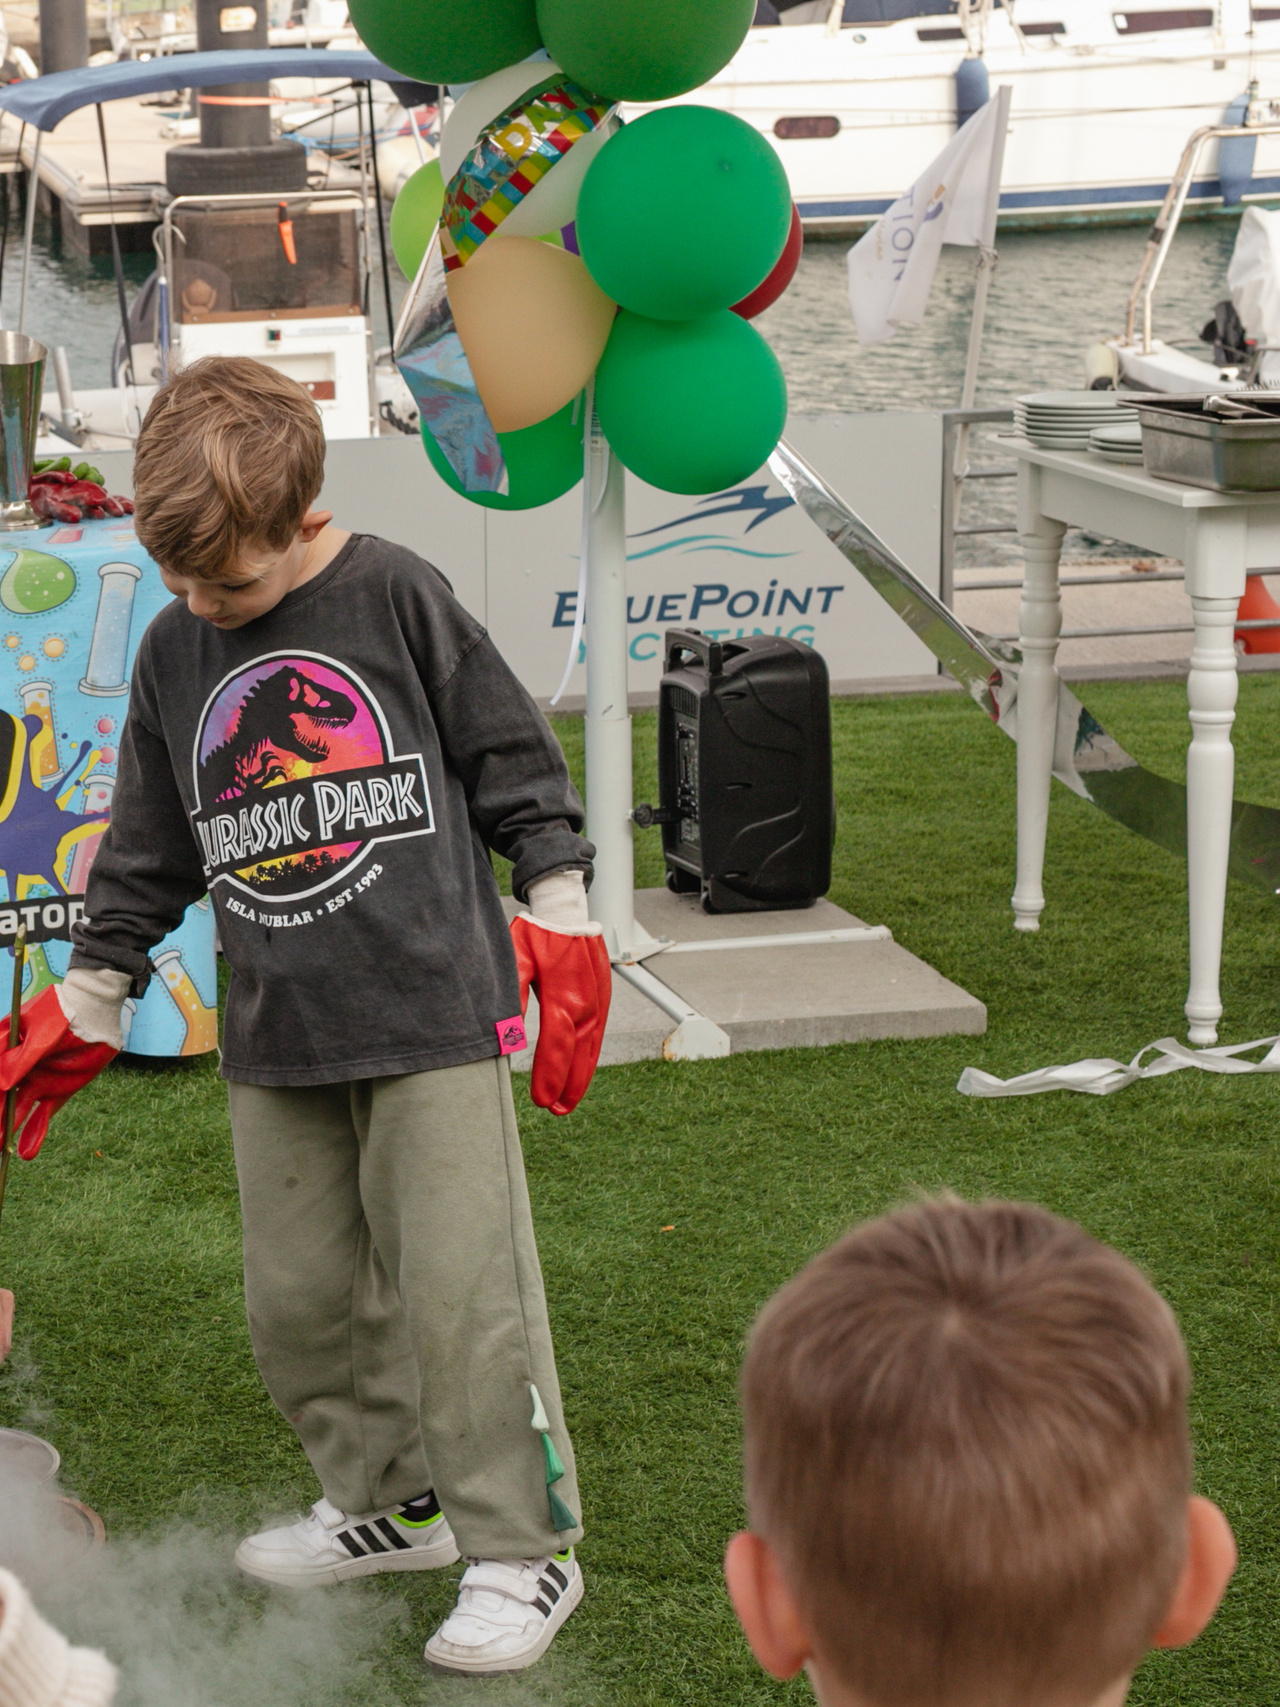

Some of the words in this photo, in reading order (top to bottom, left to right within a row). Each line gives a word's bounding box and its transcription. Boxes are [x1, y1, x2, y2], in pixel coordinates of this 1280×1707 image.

[892, 186, 915, 281] TION
[196, 793, 311, 877] JURASSIC
[313, 772, 424, 841] PARK
[225, 897, 256, 922] ISLA
[258, 910, 314, 928] NUBLAR
[325, 888, 354, 914] EST
[354, 863, 384, 893] 1993
